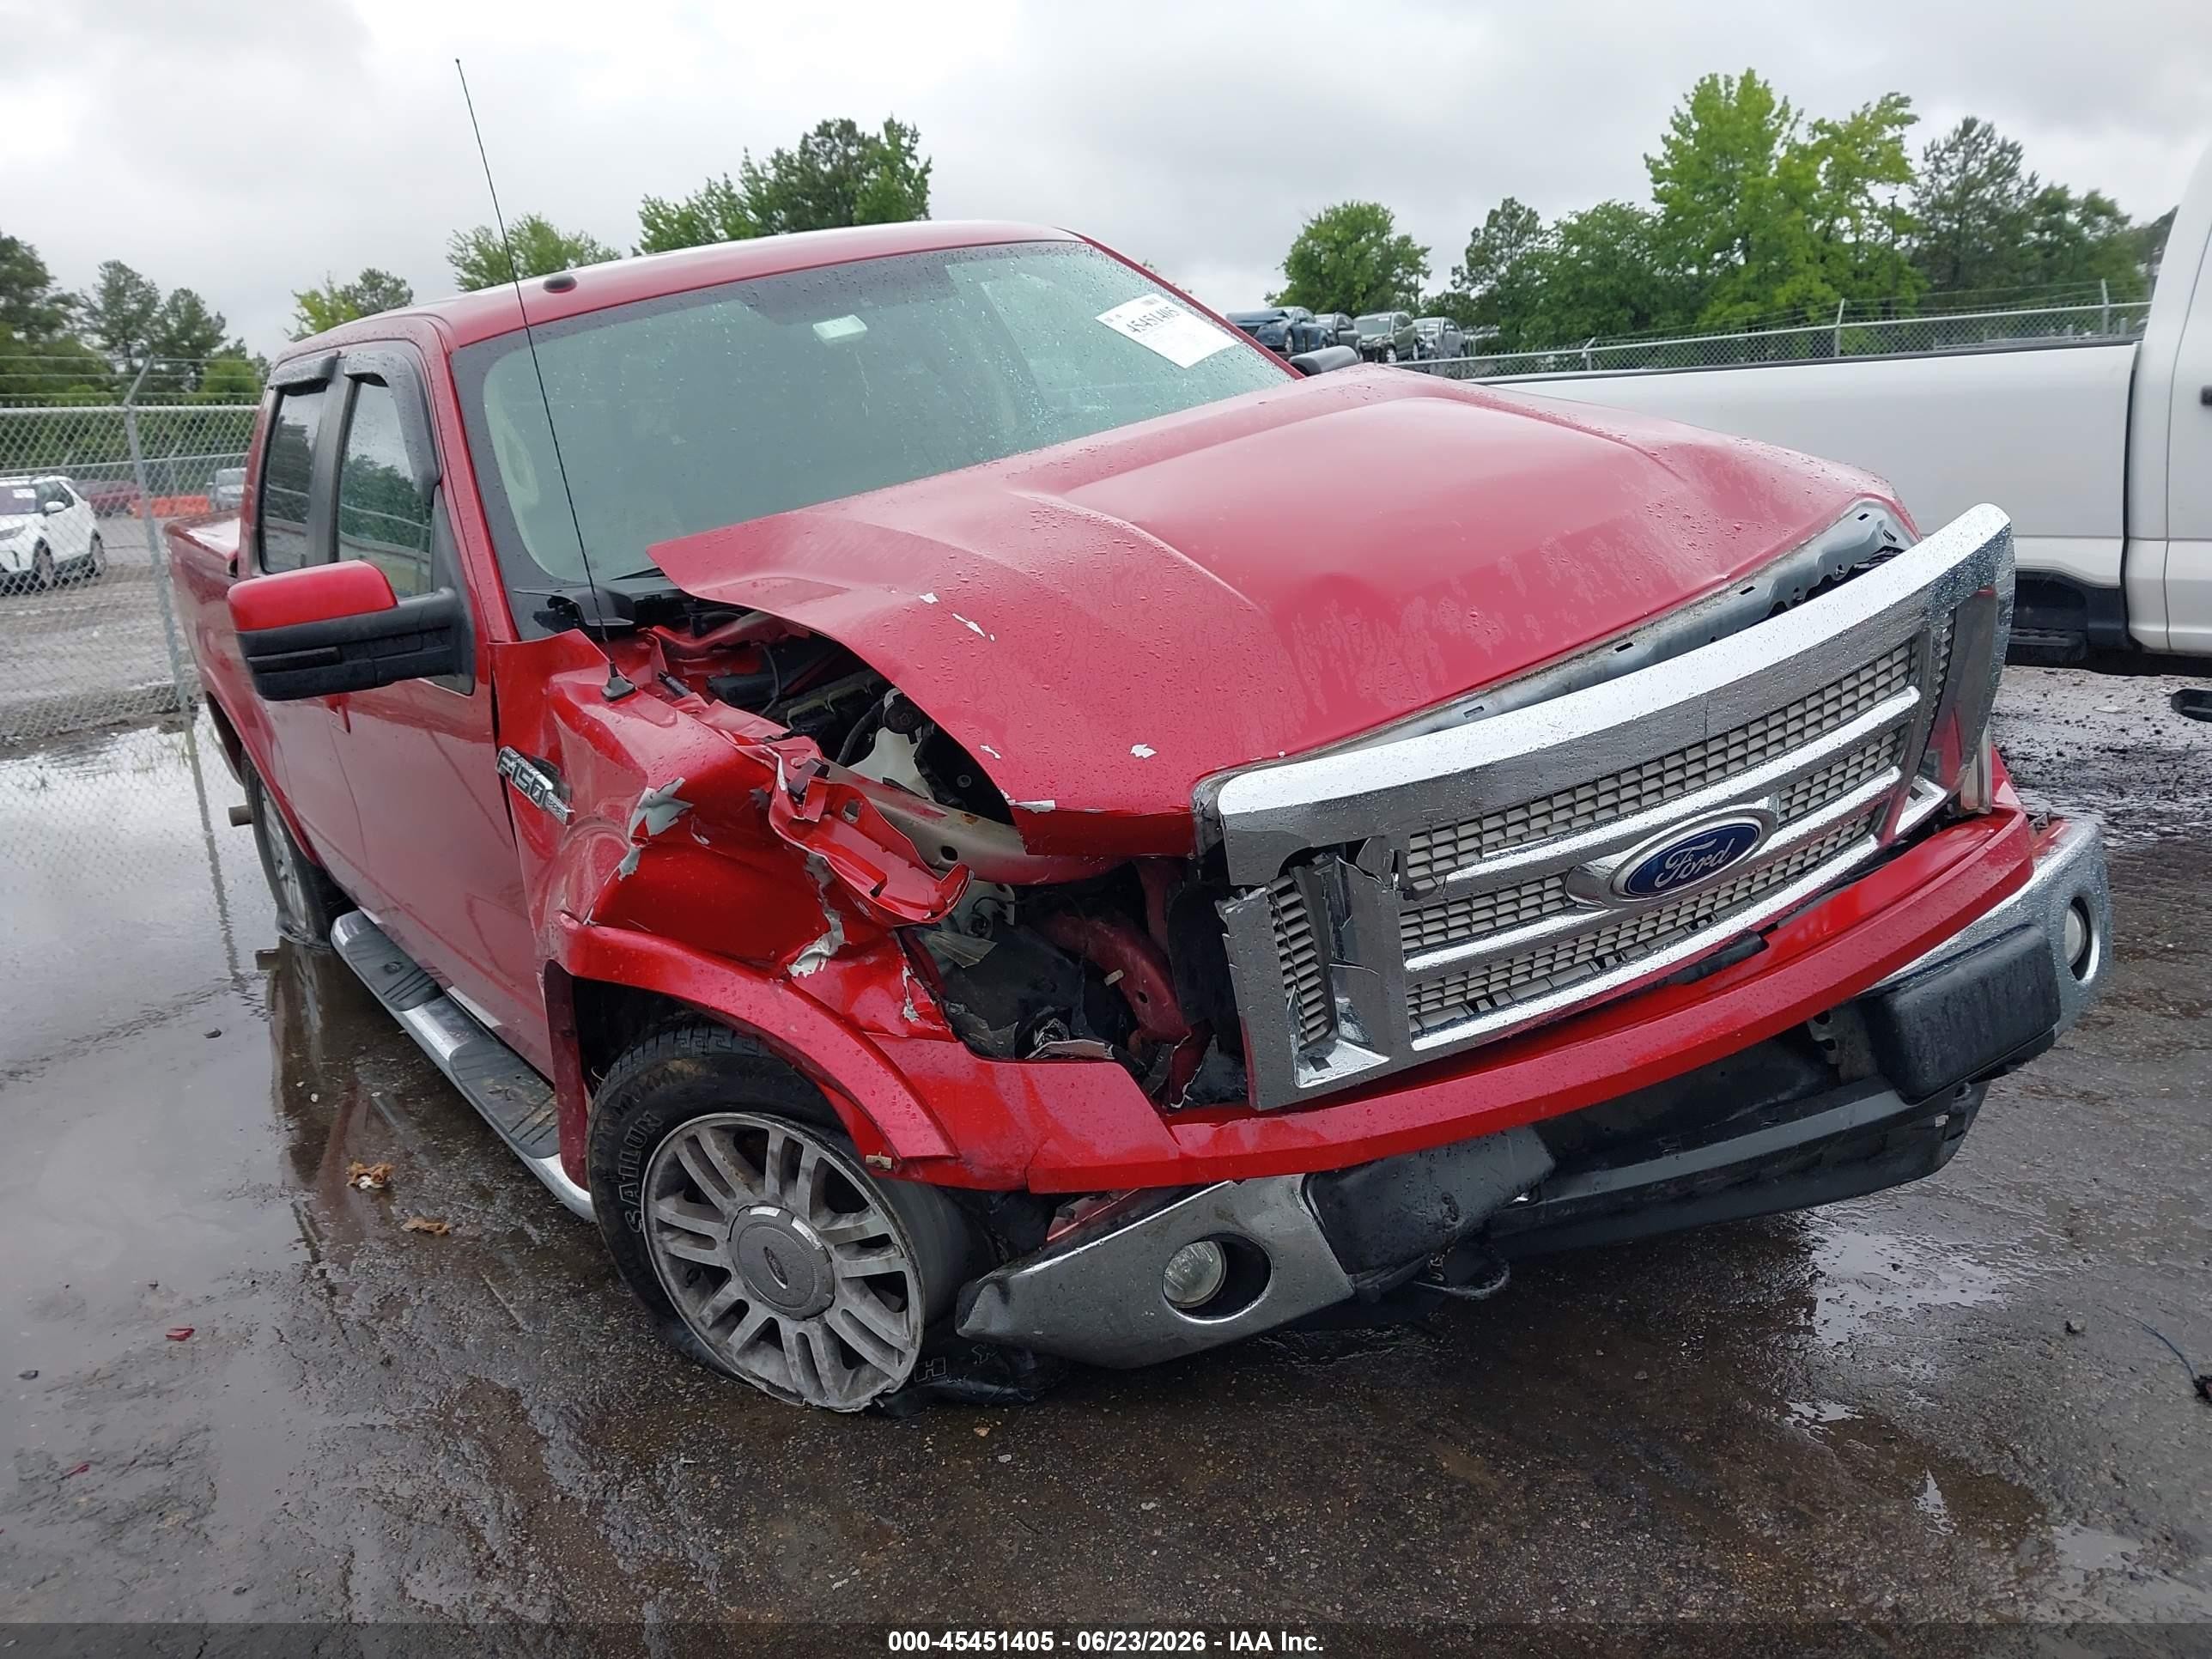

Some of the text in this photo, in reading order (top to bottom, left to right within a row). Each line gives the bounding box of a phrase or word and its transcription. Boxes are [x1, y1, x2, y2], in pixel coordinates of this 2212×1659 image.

[1126, 306, 1180, 333] 45451405
[1654, 837, 1735, 888] Ford
[617, 1109, 665, 1233] SAILUN
